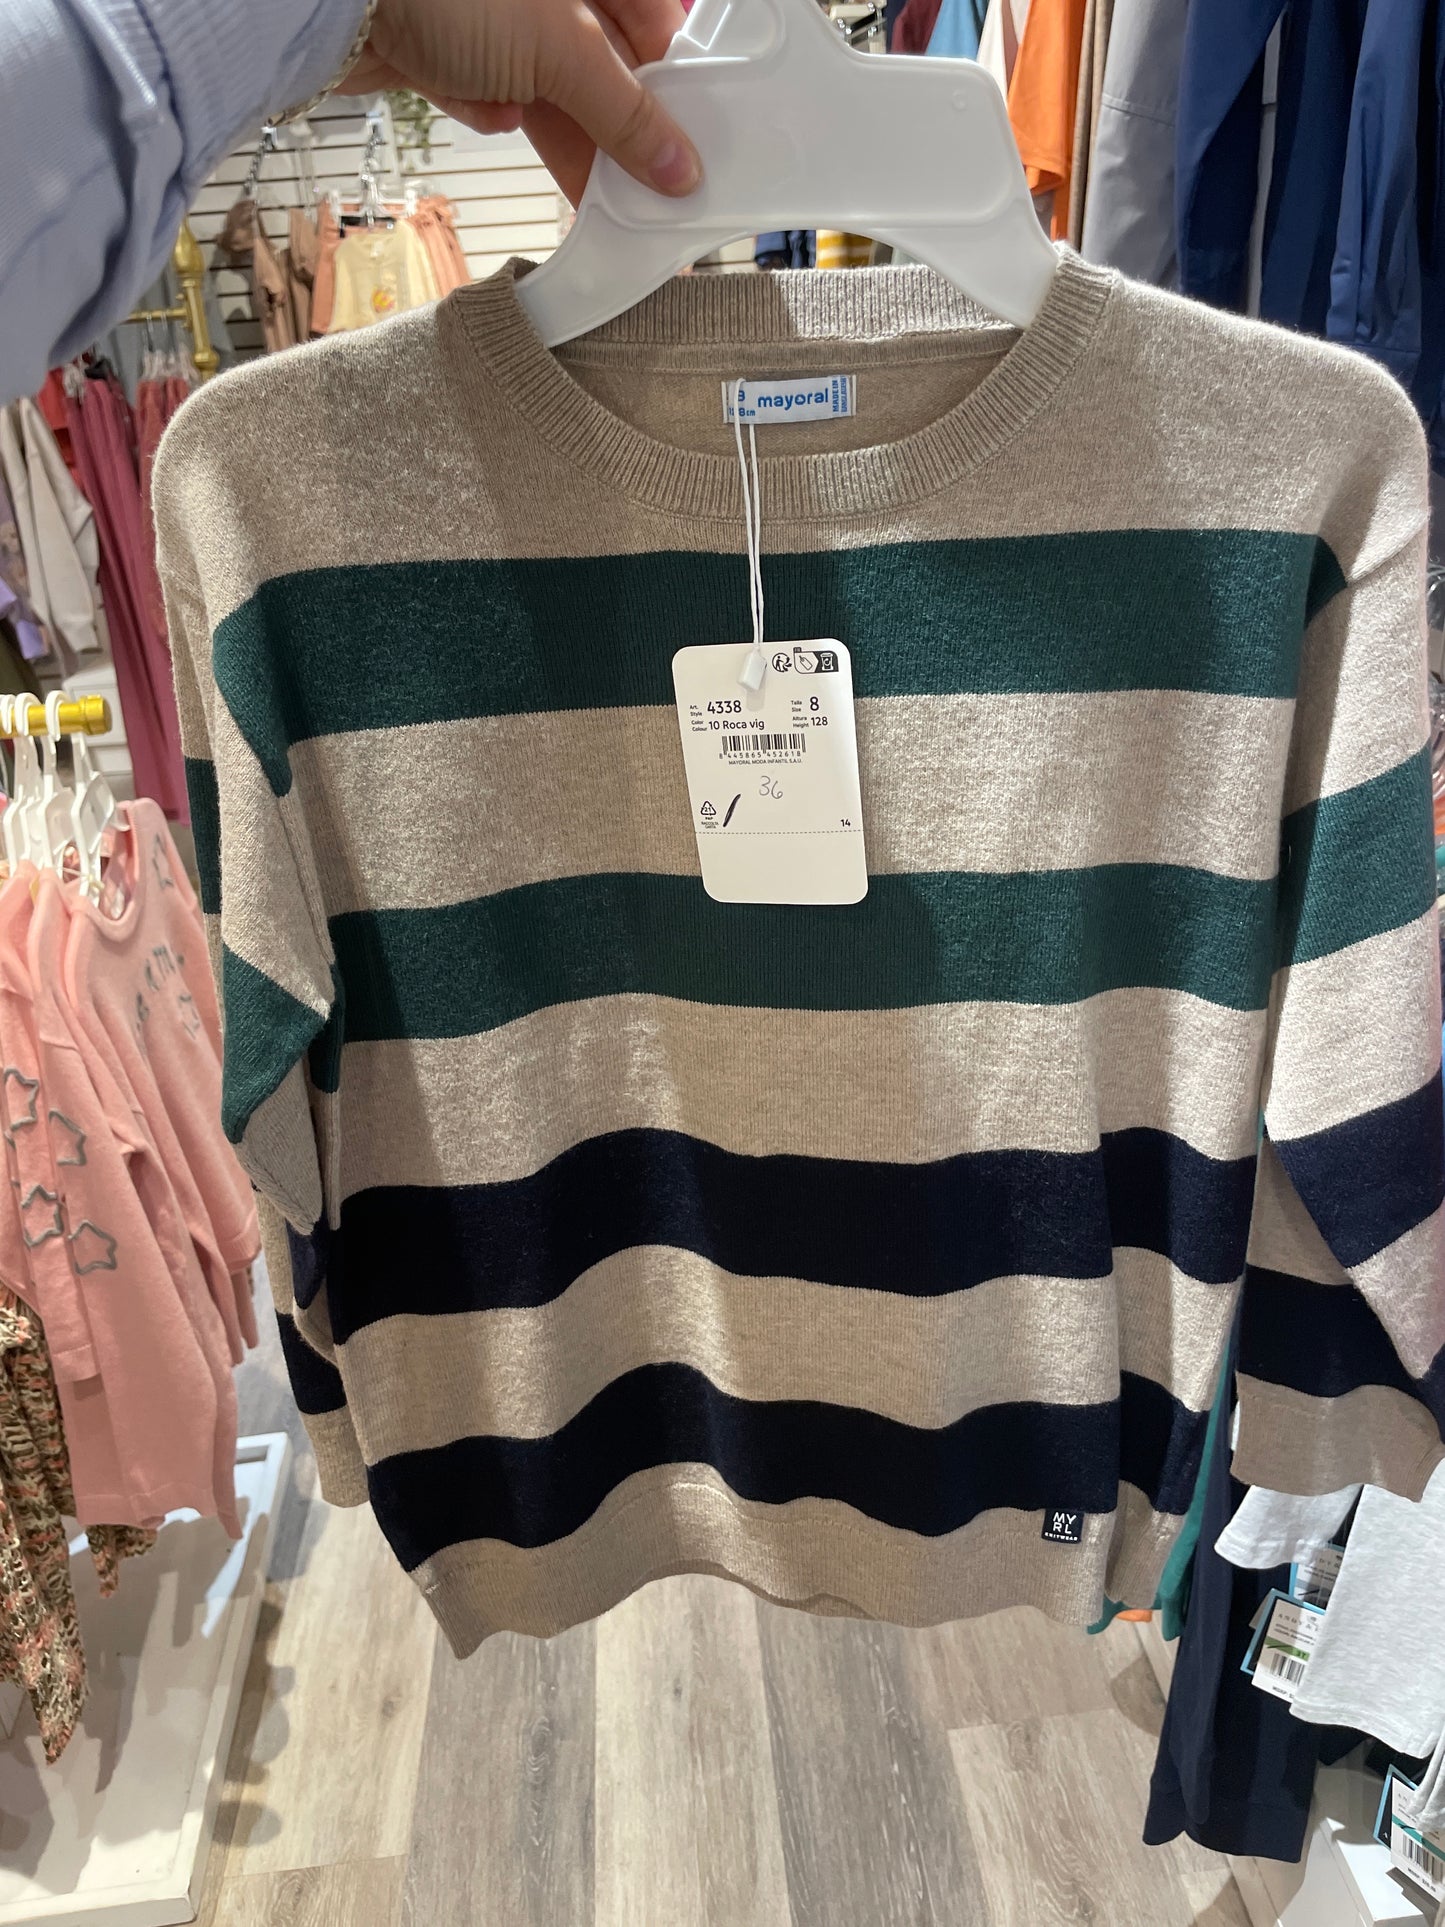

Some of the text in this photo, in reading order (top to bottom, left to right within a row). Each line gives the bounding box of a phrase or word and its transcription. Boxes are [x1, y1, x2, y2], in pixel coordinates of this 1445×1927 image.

[757, 387, 829, 411] mayoral
[707, 699, 742, 714] 4338
[809, 696, 820, 711] 8
[708, 718, 765, 731] 10 Roca vig
[810, 716, 829, 726] 128
[758, 775, 784, 800] 36
[840, 818, 851, 827] 14
[1052, 1511, 1077, 1525] MY
[1052, 1521, 1072, 1534] RL
